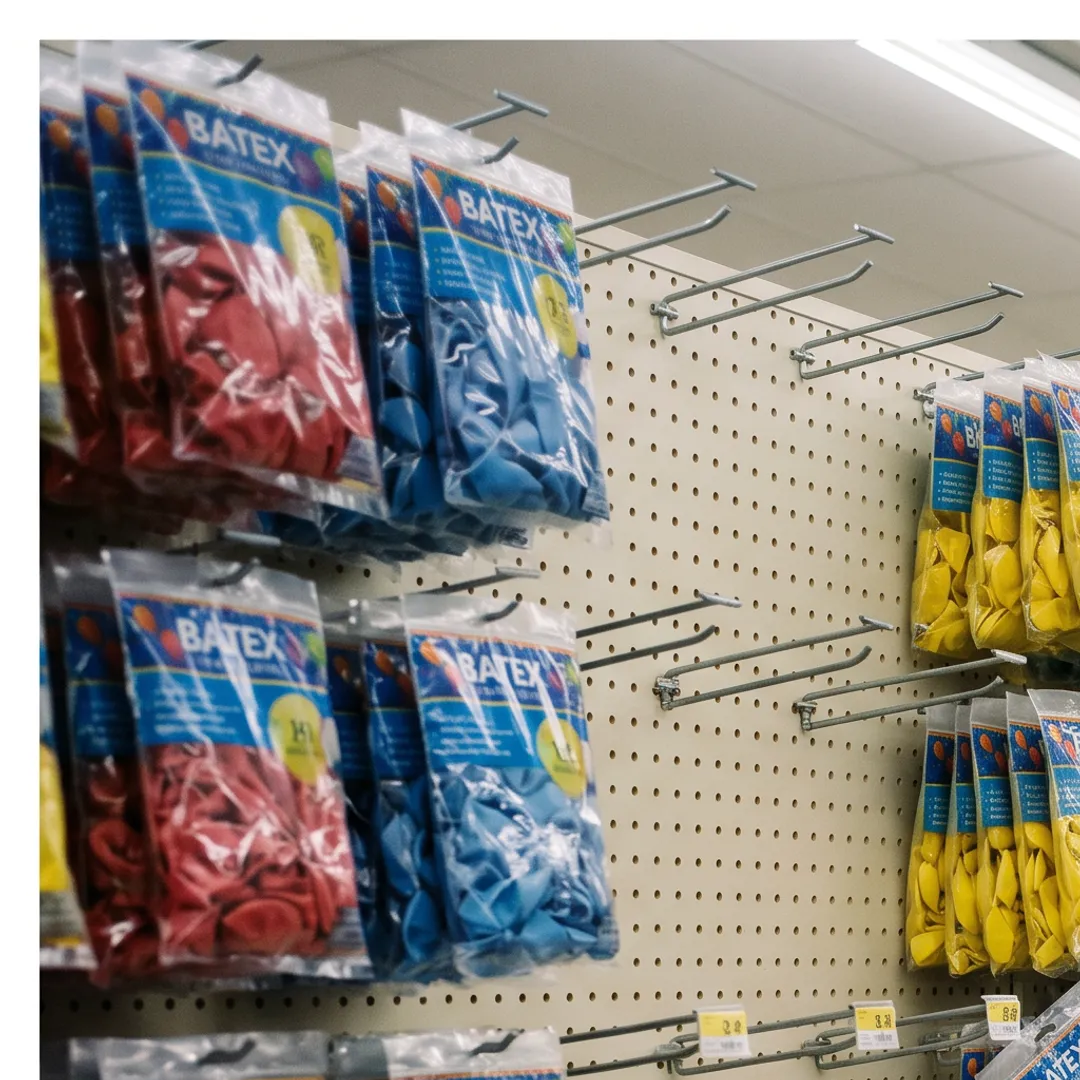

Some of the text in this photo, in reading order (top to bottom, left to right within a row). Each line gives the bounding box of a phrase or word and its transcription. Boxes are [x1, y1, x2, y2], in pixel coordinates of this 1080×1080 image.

[184, 110, 296, 174] BATEX
[457, 189, 543, 247] BATEX
[177, 617, 286, 661] BATEX
[457, 652, 549, 688] BATEX
